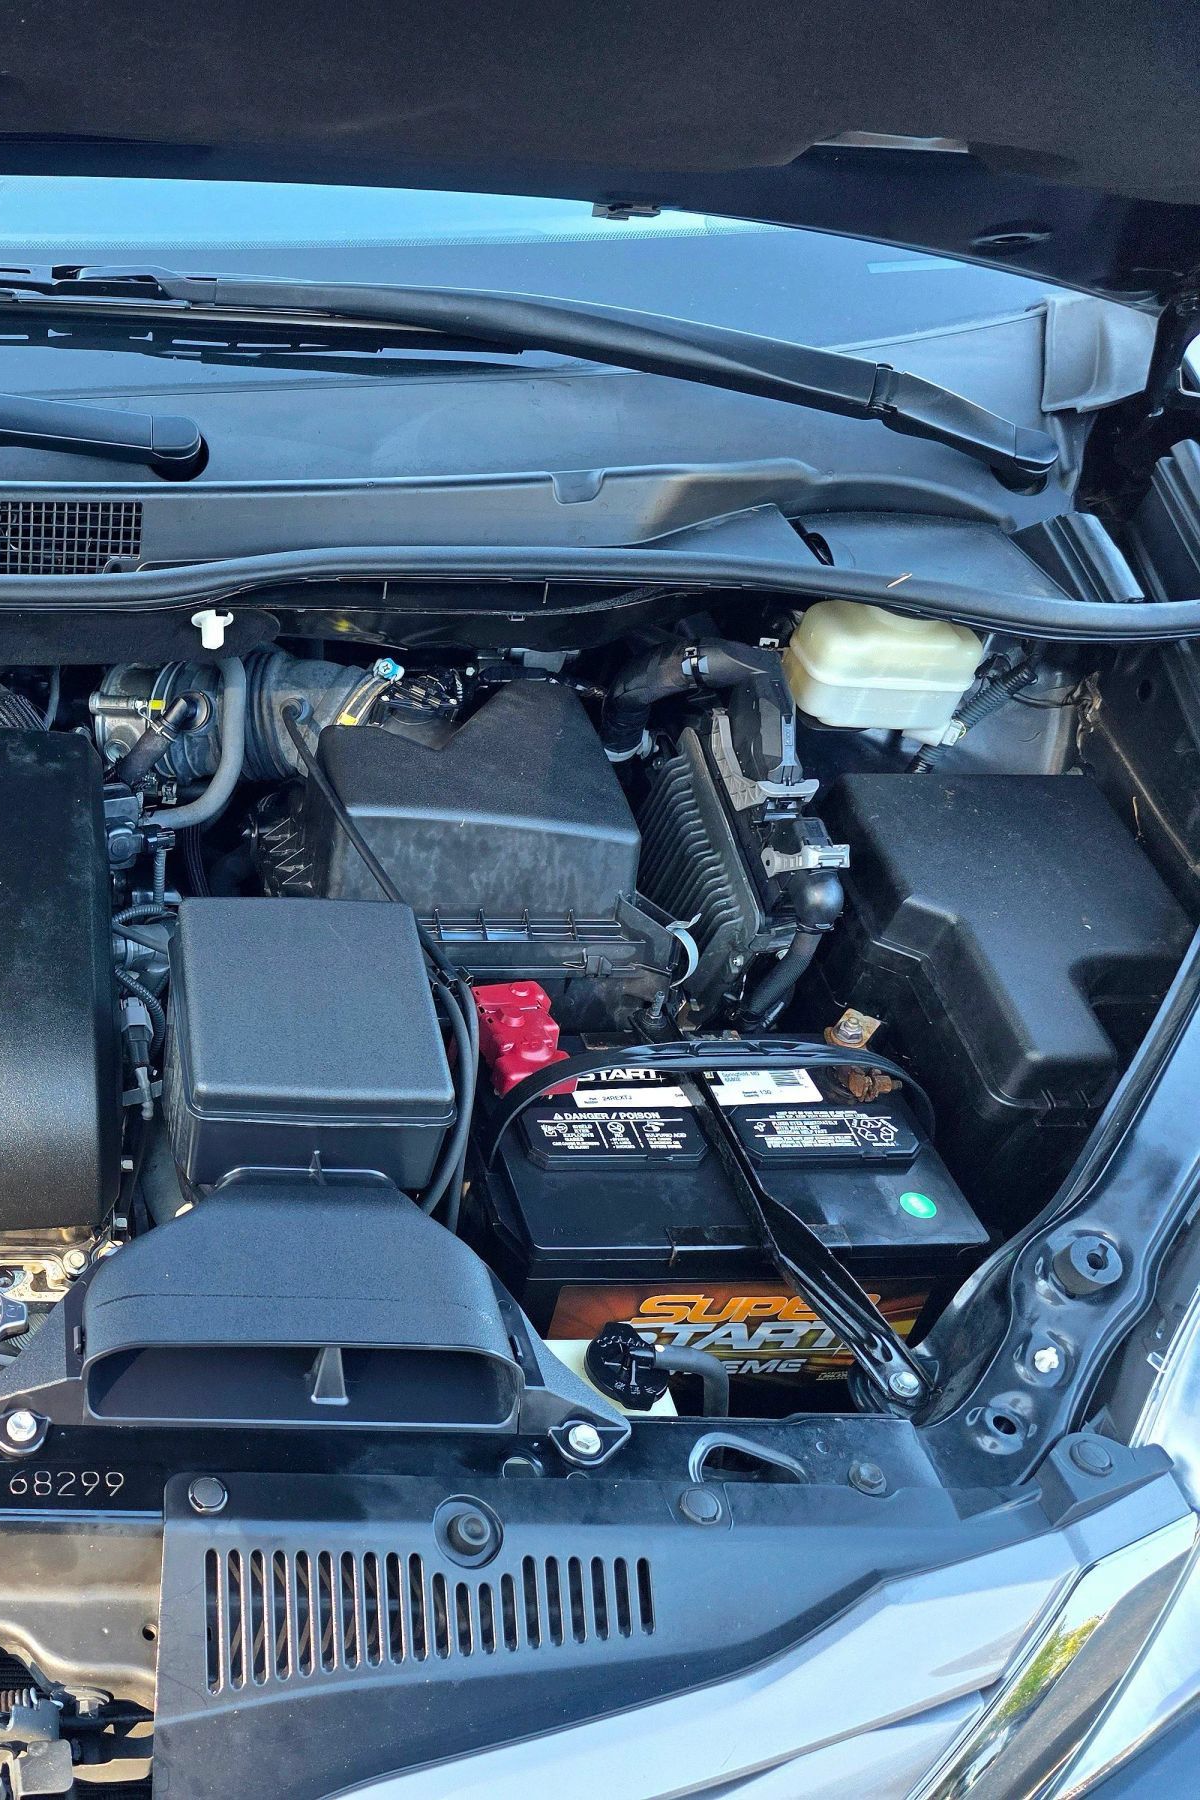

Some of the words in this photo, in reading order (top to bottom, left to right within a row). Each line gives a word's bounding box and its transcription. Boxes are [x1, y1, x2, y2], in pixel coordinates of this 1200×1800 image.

[564, 1112, 609, 1120] DANGER
[619, 1112, 660, 1120] POISON
[631, 1294, 881, 1324] SUPE
[9, 1471, 125, 1496] 68299
